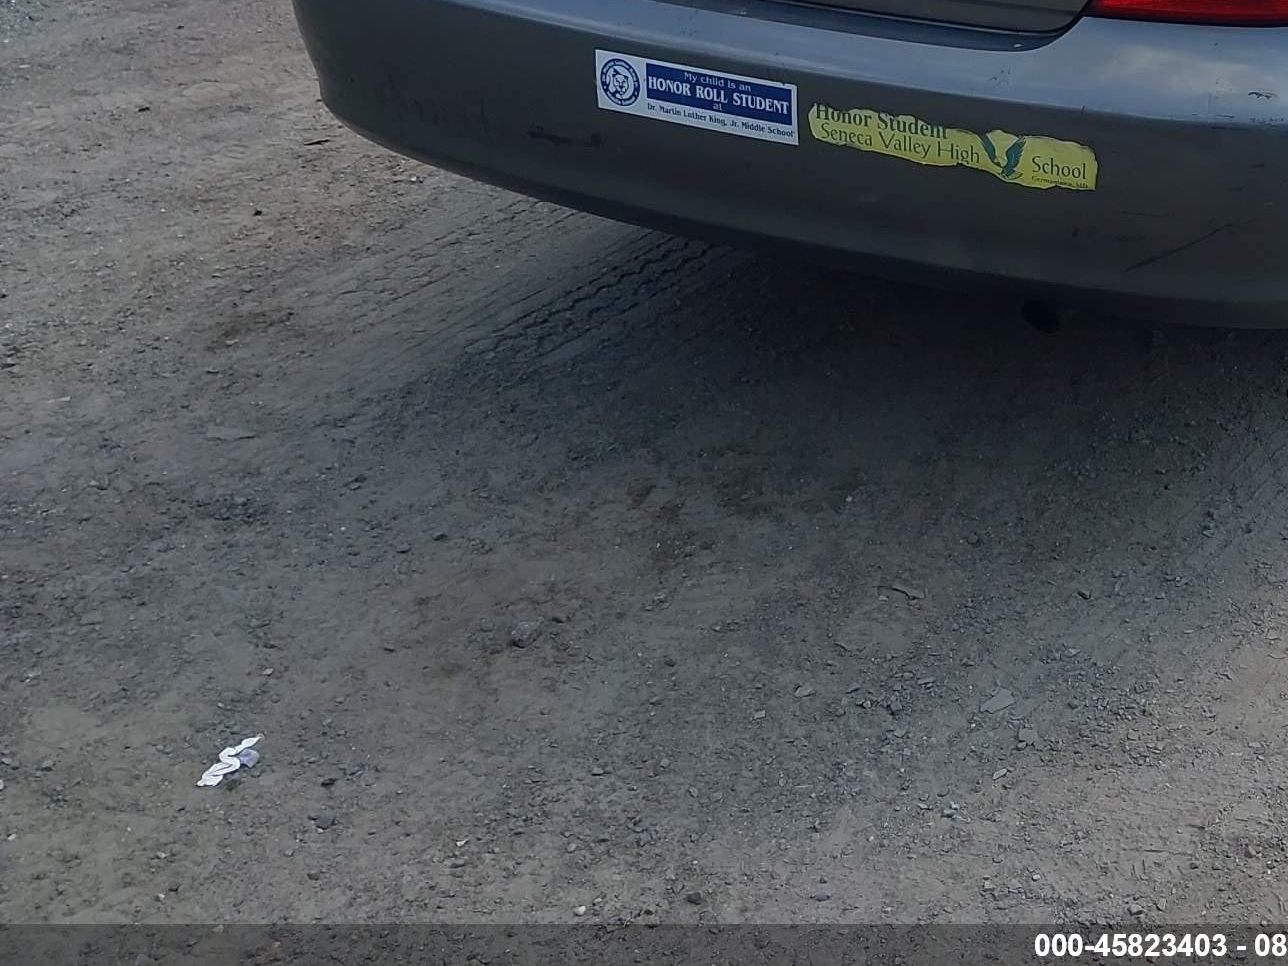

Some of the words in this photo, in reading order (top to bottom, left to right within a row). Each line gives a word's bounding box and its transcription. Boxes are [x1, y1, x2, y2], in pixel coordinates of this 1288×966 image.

[648, 76, 691, 96] HONOR
[696, 85, 728, 104] ROLL
[733, 92, 789, 114] STUDENT
[684, 72, 697, 83] My
[701, 76, 724, 87] child
[739, 84, 751, 92] an
[647, 103, 658, 112] Dr.
[660, 105, 681, 117] Martin
[683, 110, 707, 122] Luther
[709, 115, 728, 127] King,
[730, 120, 740, 128] Jr.
[742, 122, 766, 132] Middle
[768, 127, 794, 138] School
[713, 103, 723, 111] at
[815, 105, 873, 127] Honor
[877, 113, 949, 140] Student
[820, 122, 873, 147] Seneca
[879, 132, 932, 159] Valley
[938, 141, 980, 164] High
[1032, 155, 1087, 180] School
